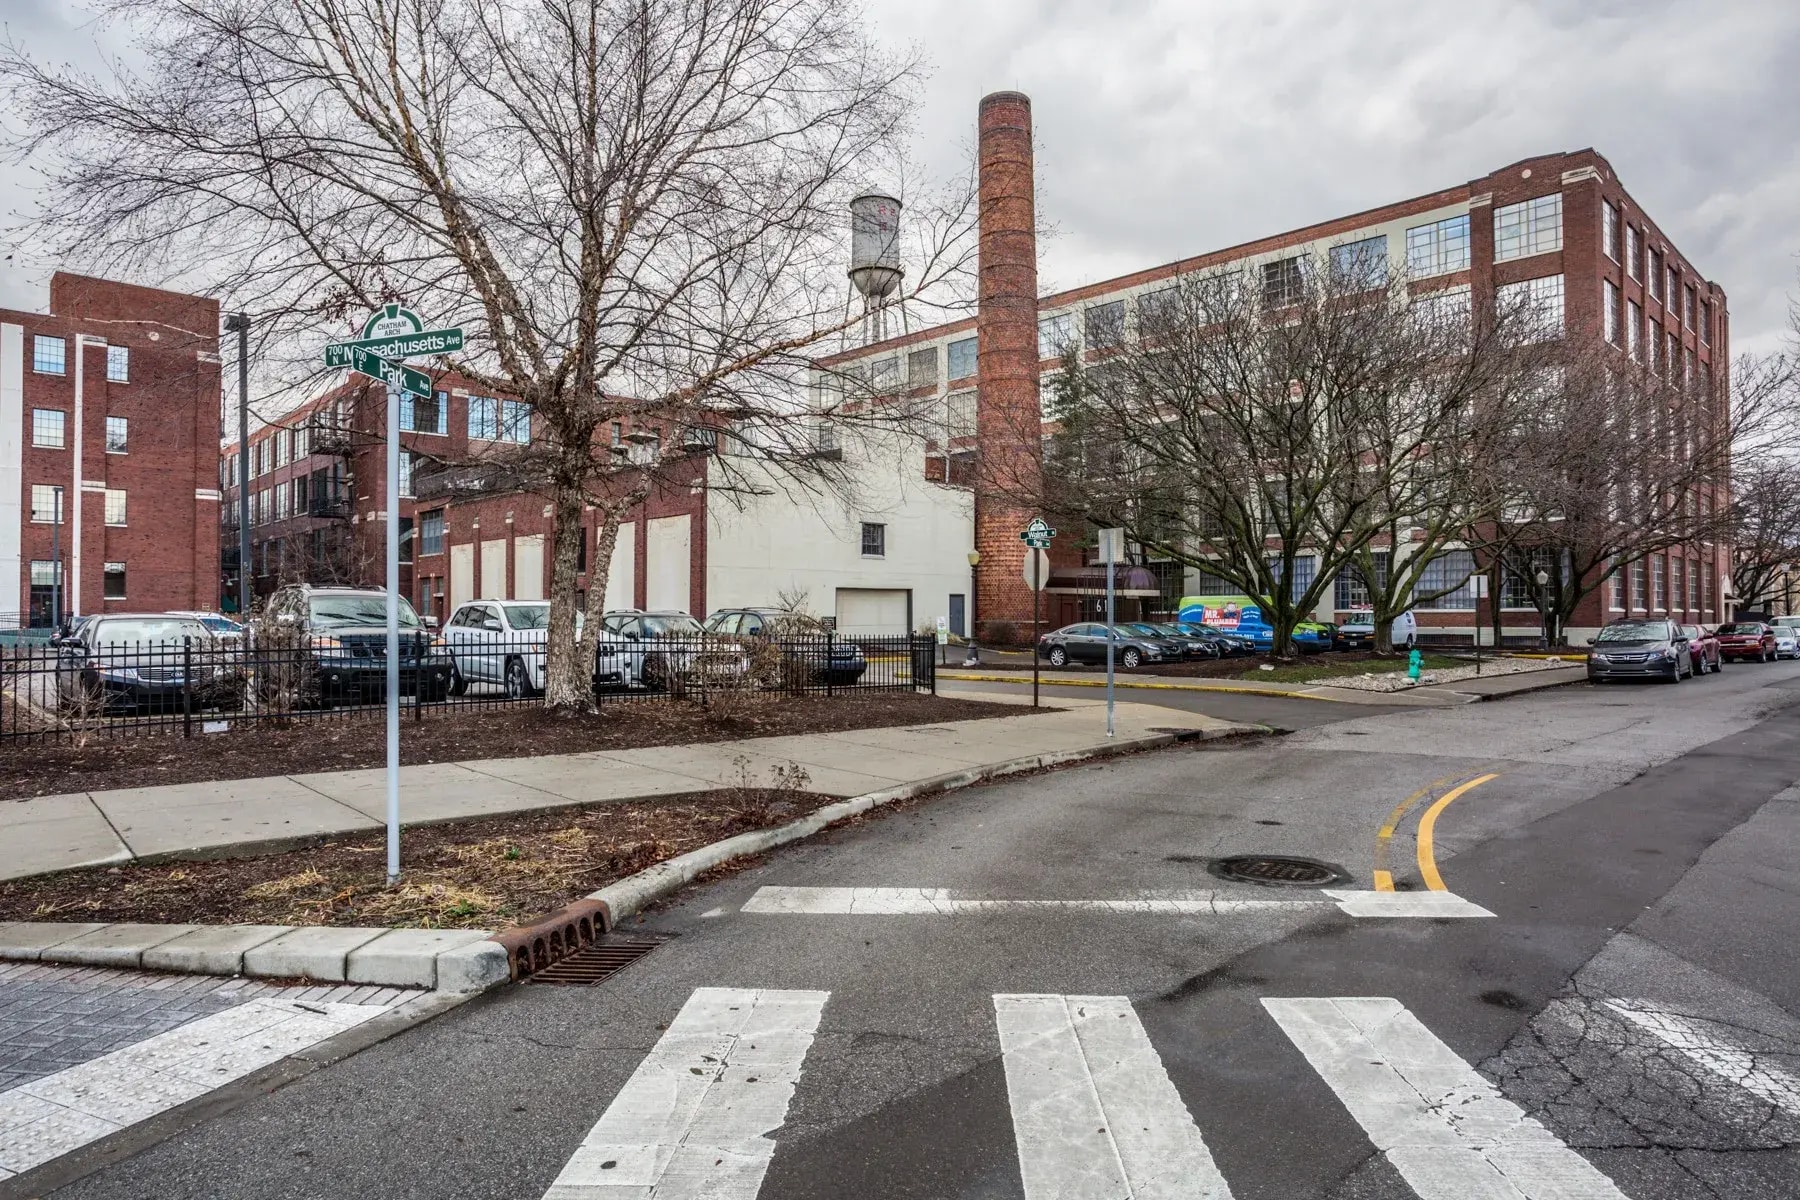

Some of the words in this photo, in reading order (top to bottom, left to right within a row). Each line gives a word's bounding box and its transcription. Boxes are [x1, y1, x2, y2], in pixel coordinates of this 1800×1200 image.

[377, 320, 407, 330] CHATHAM
[328, 345, 342, 356] 700
[344, 336, 445, 361] Msachusetts
[446, 335, 460, 346] Ave
[333, 355, 339, 365] N
[355, 348, 367, 362] 700
[359, 361, 364, 371] E
[380, 359, 407, 387] Park
[420, 380, 429, 392] Ave
[1028, 530, 1048, 539] Walnut
[1205, 609, 1220, 619] MR.
[1206, 618, 1238, 626] PLUMBER
